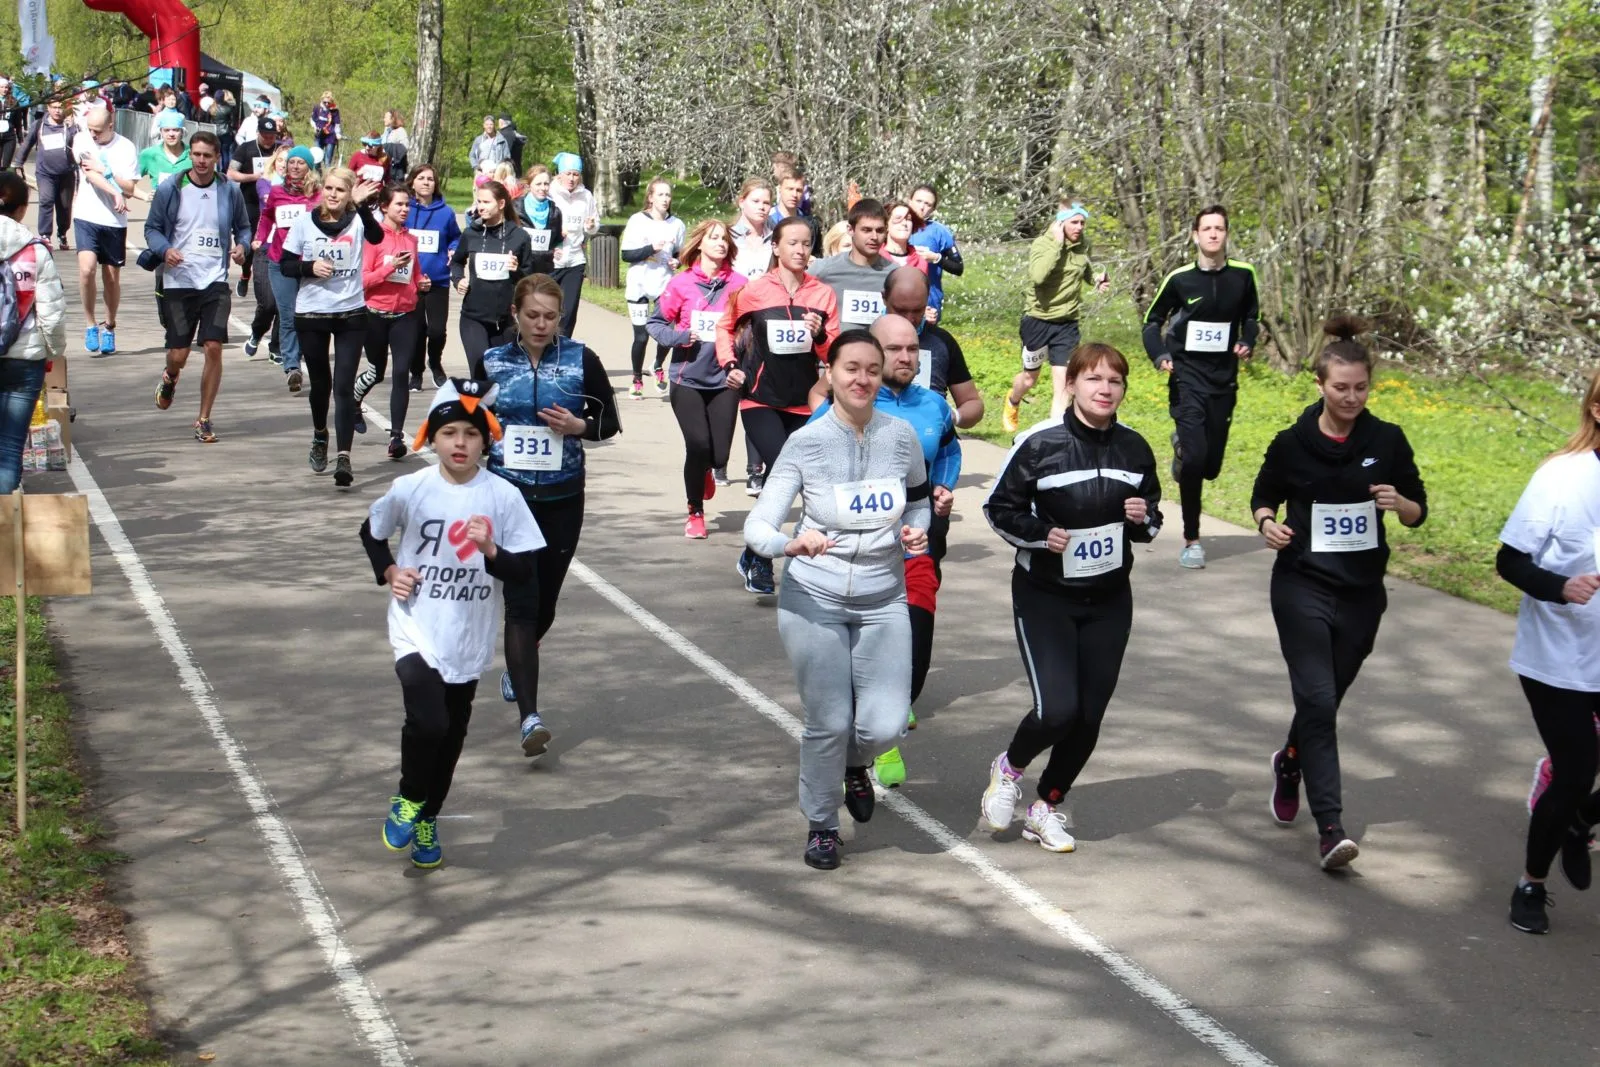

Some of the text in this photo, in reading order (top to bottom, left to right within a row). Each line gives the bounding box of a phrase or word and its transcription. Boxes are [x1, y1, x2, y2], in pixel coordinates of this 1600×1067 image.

[198, 236, 220, 248] 381
[421, 236, 434, 245] 13
[532, 235, 546, 244] 40
[482, 260, 505, 271] 387
[851, 299, 880, 314] 391
[698, 319, 716, 331] 32
[775, 329, 806, 343] 382
[1195, 329, 1222, 341] 354
[513, 436, 552, 456] 331
[849, 491, 894, 514] 440
[1323, 515, 1368, 535] 398
[415, 518, 446, 557] Я
[1073, 536, 1114, 561] 403
[429, 583, 492, 602] БЛАГО
